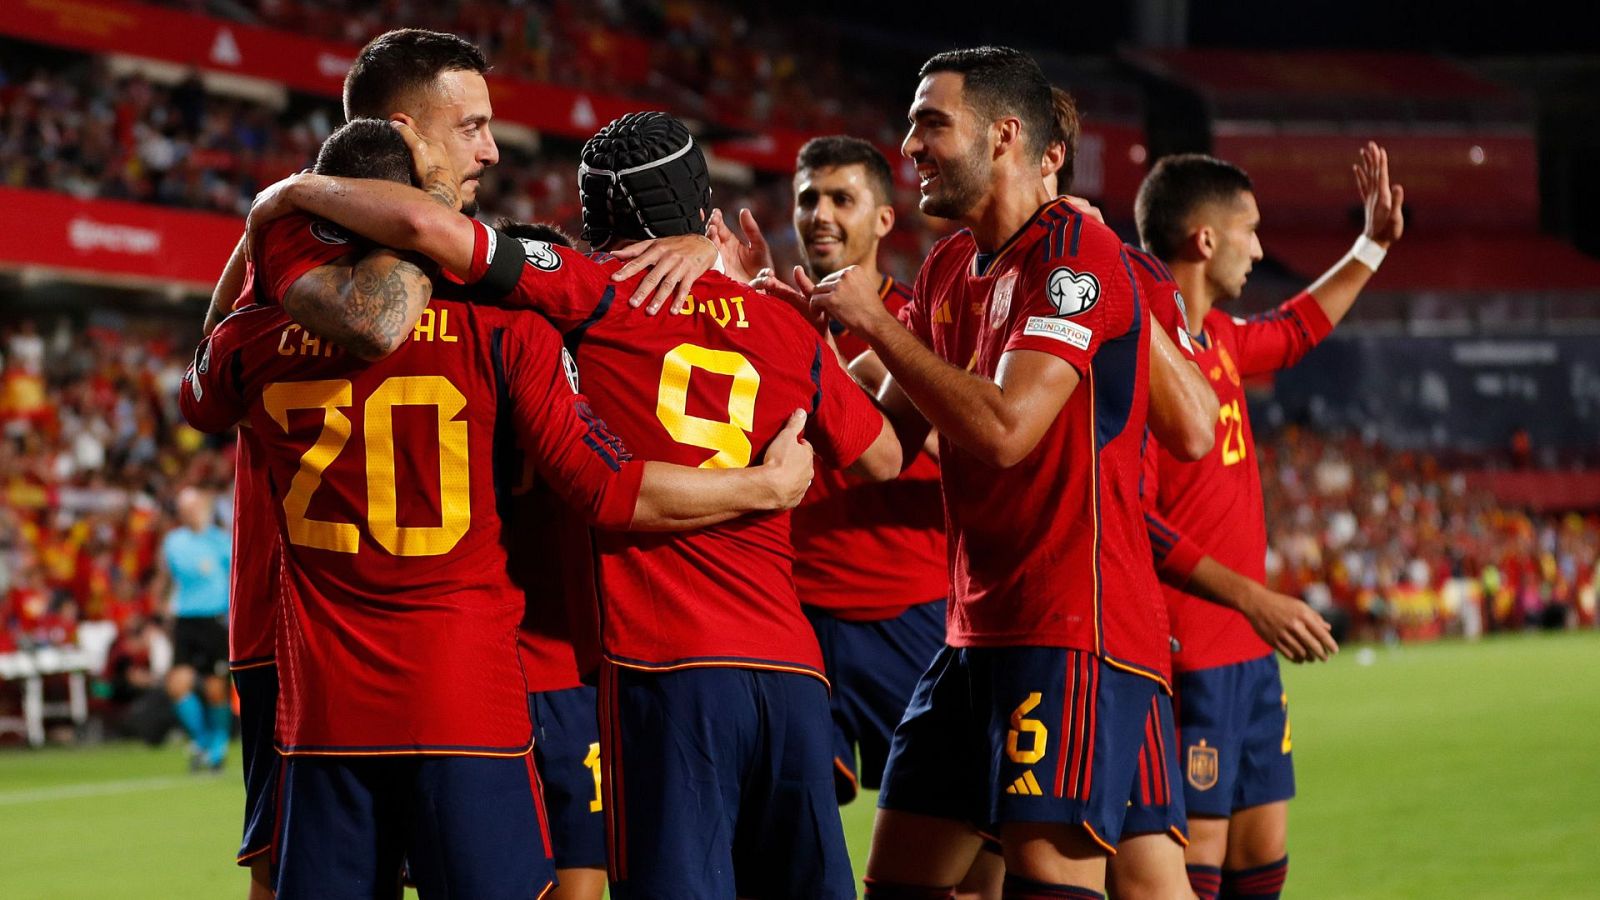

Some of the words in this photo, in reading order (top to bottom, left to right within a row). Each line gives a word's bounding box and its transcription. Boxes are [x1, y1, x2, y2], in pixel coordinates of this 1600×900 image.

[1027, 322, 1089, 343] FOUNDATION
[656, 343, 760, 468] 9
[1219, 399, 1247, 466] 21
[263, 375, 471, 556] 20
[1006, 692, 1048, 764] 6
